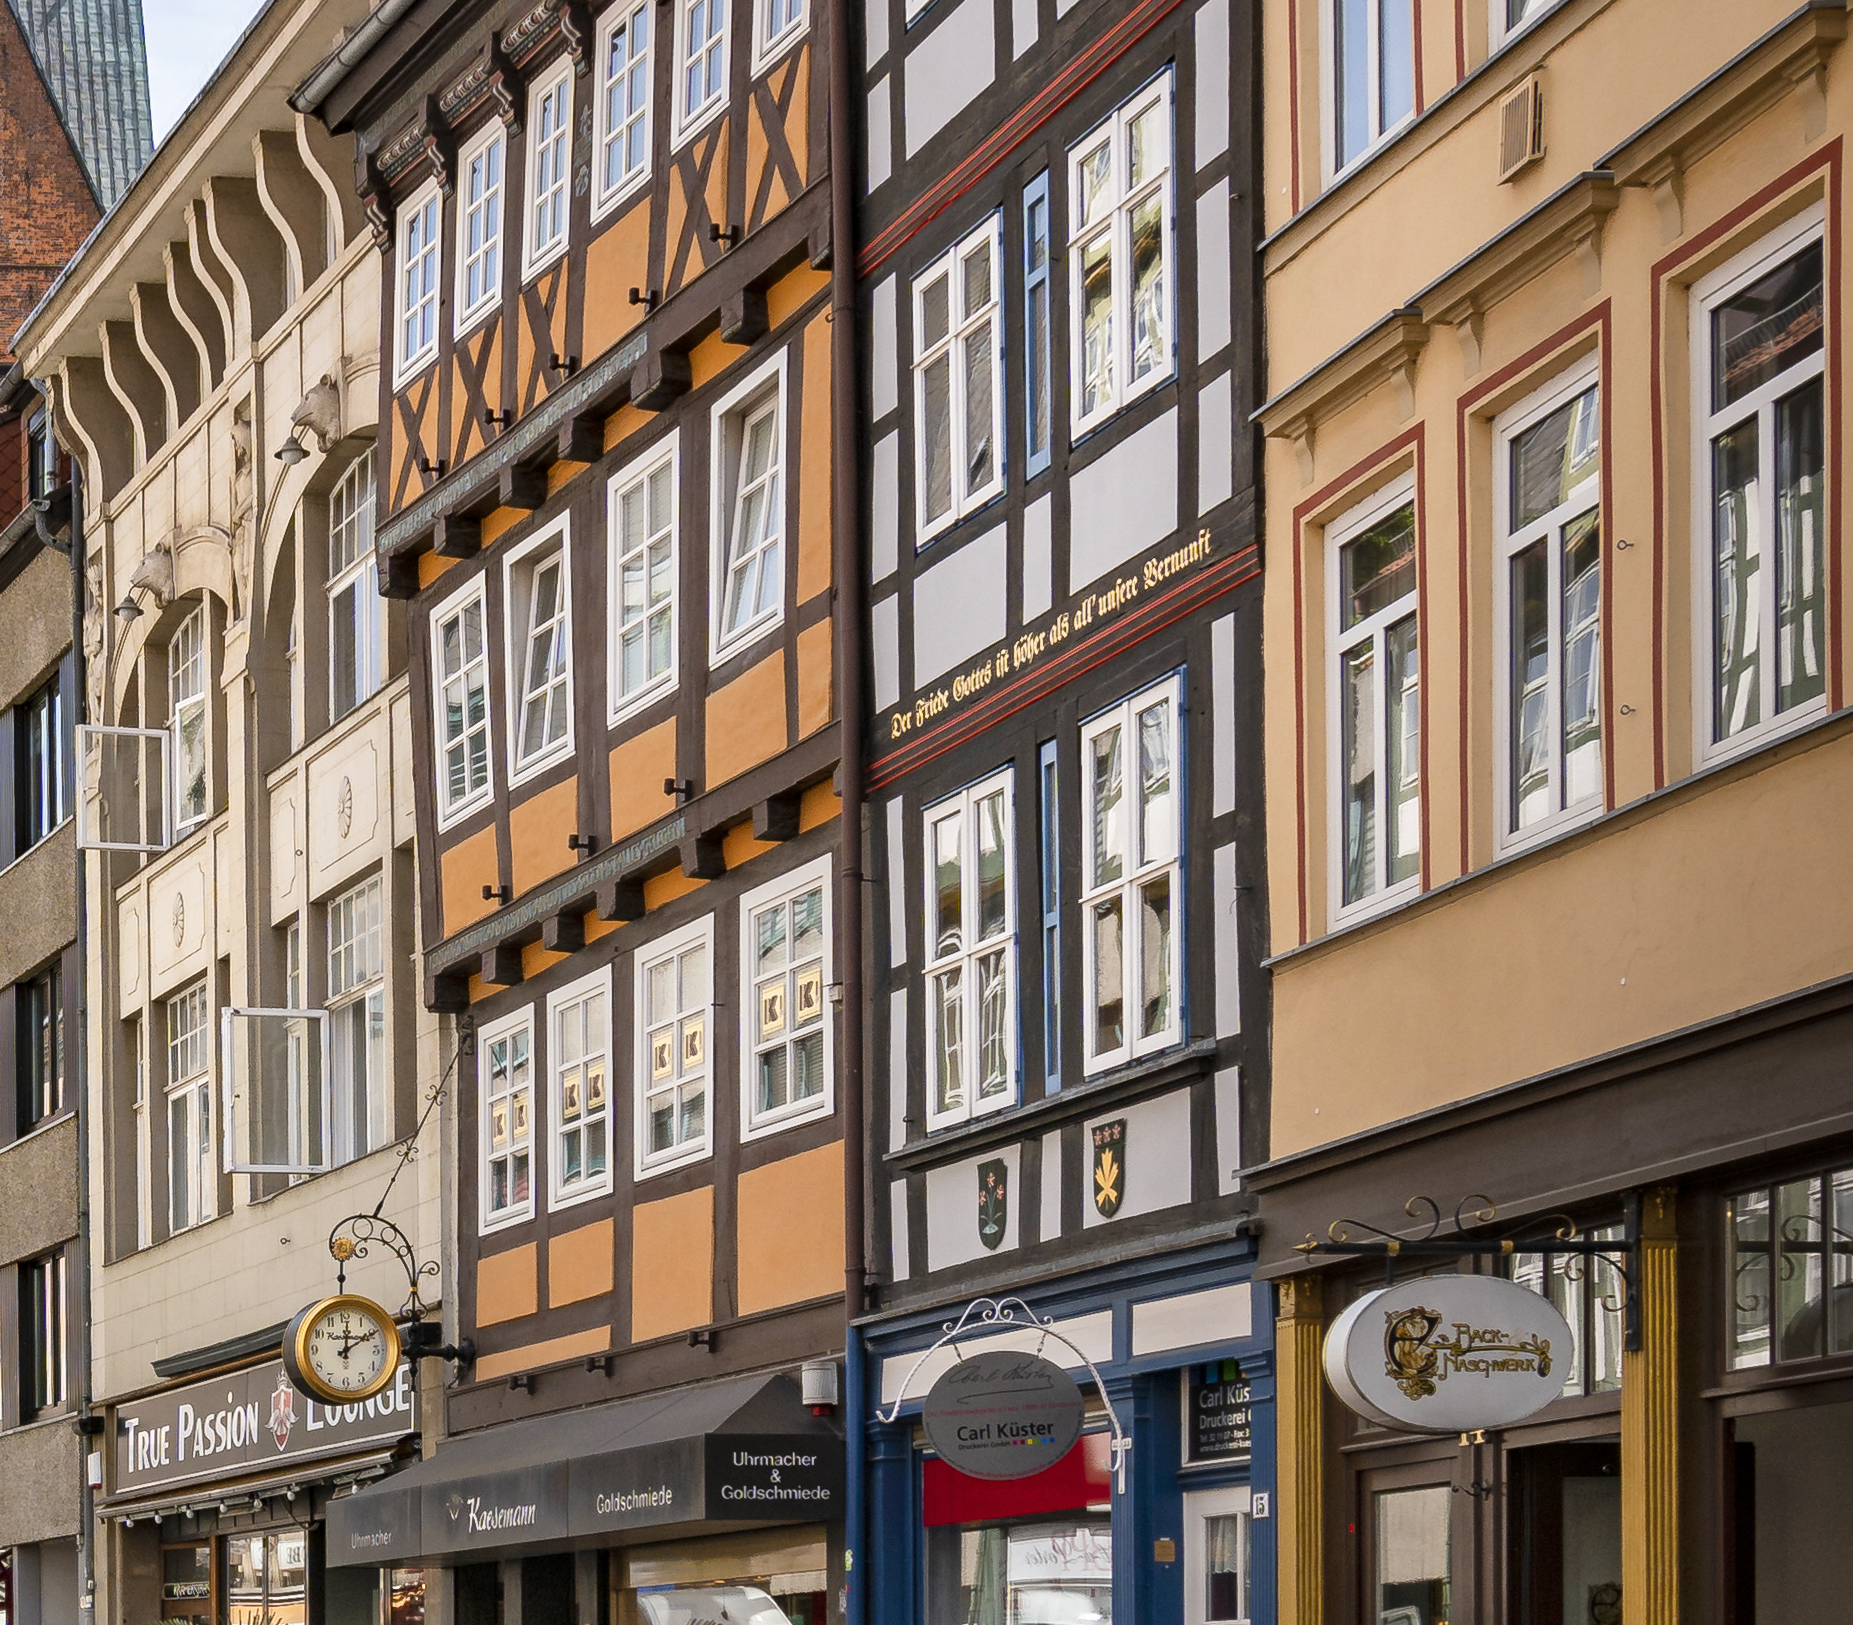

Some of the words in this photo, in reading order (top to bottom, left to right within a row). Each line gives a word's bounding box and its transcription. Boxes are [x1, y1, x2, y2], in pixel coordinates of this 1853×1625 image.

[891, 711, 912, 739] Der
[915, 688, 949, 727] Friede
[952, 660, 992, 701] Gottes
[996, 649, 1009, 678] ist
[1013, 630, 1046, 671] höher
[1049, 612, 1069, 646] als
[1098, 575, 1138, 617] unsere
[1143, 528, 1212, 590] Vernunft
[1199, 1386, 1223, 1408] Carl
[1199, 1408, 1246, 1429] Druckerei
[957, 1424, 991, 1442] Carl
[998, 1421, 1054, 1438] Küster
[958, 1441, 989, 1451] Druckerei
[733, 1451, 817, 1466] Uhrmacher
[770, 1469, 781, 1483] &
[721, 1485, 831, 1500] Goldschmiede
[351, 1529, 393, 1549] Uhrmacher
[467, 1496, 537, 1534] Kaesemann
[596, 1485, 673, 1514] Goldschmiede
